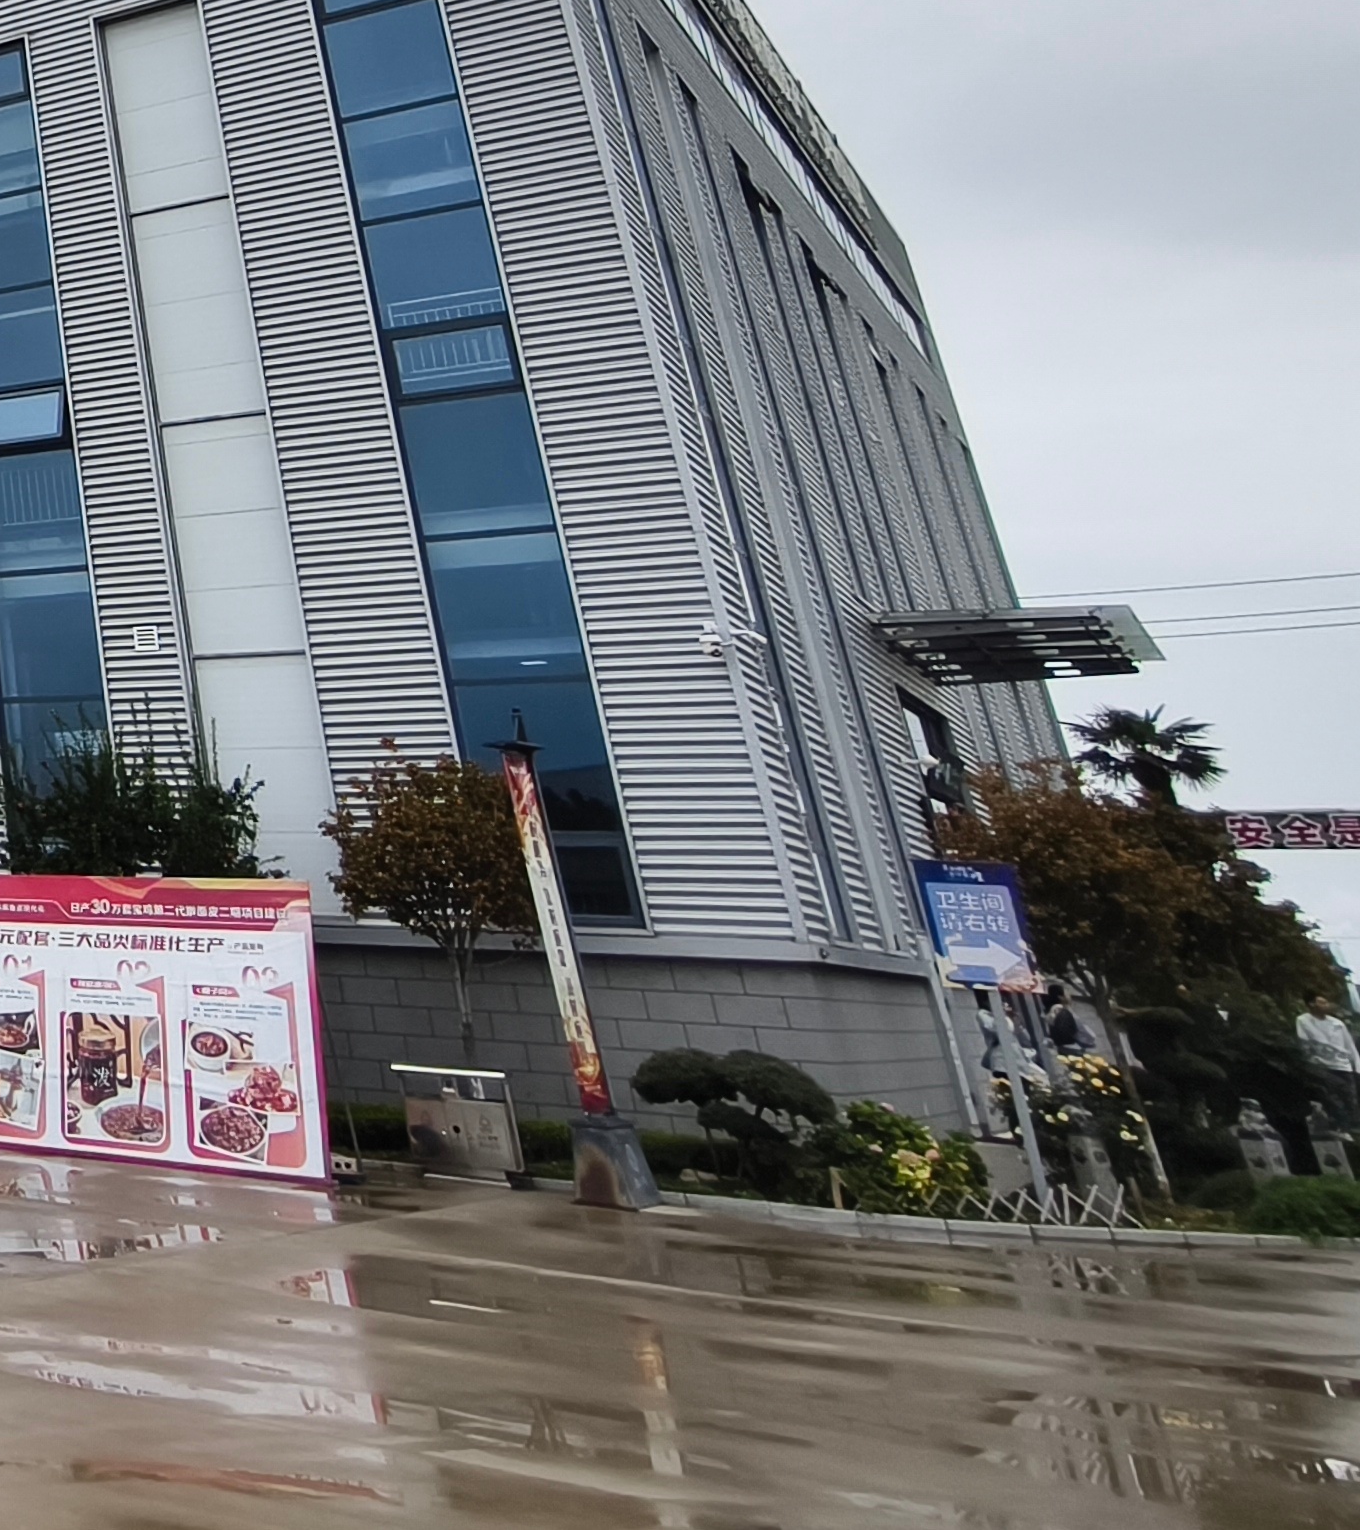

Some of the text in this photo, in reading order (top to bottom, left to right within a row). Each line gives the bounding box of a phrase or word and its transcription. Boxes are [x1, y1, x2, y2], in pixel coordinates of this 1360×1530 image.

[1224, 812, 1360, 849] 安全是
[934, 890, 1006, 912] 卫生间
[939, 912, 1010, 933] 请右转
